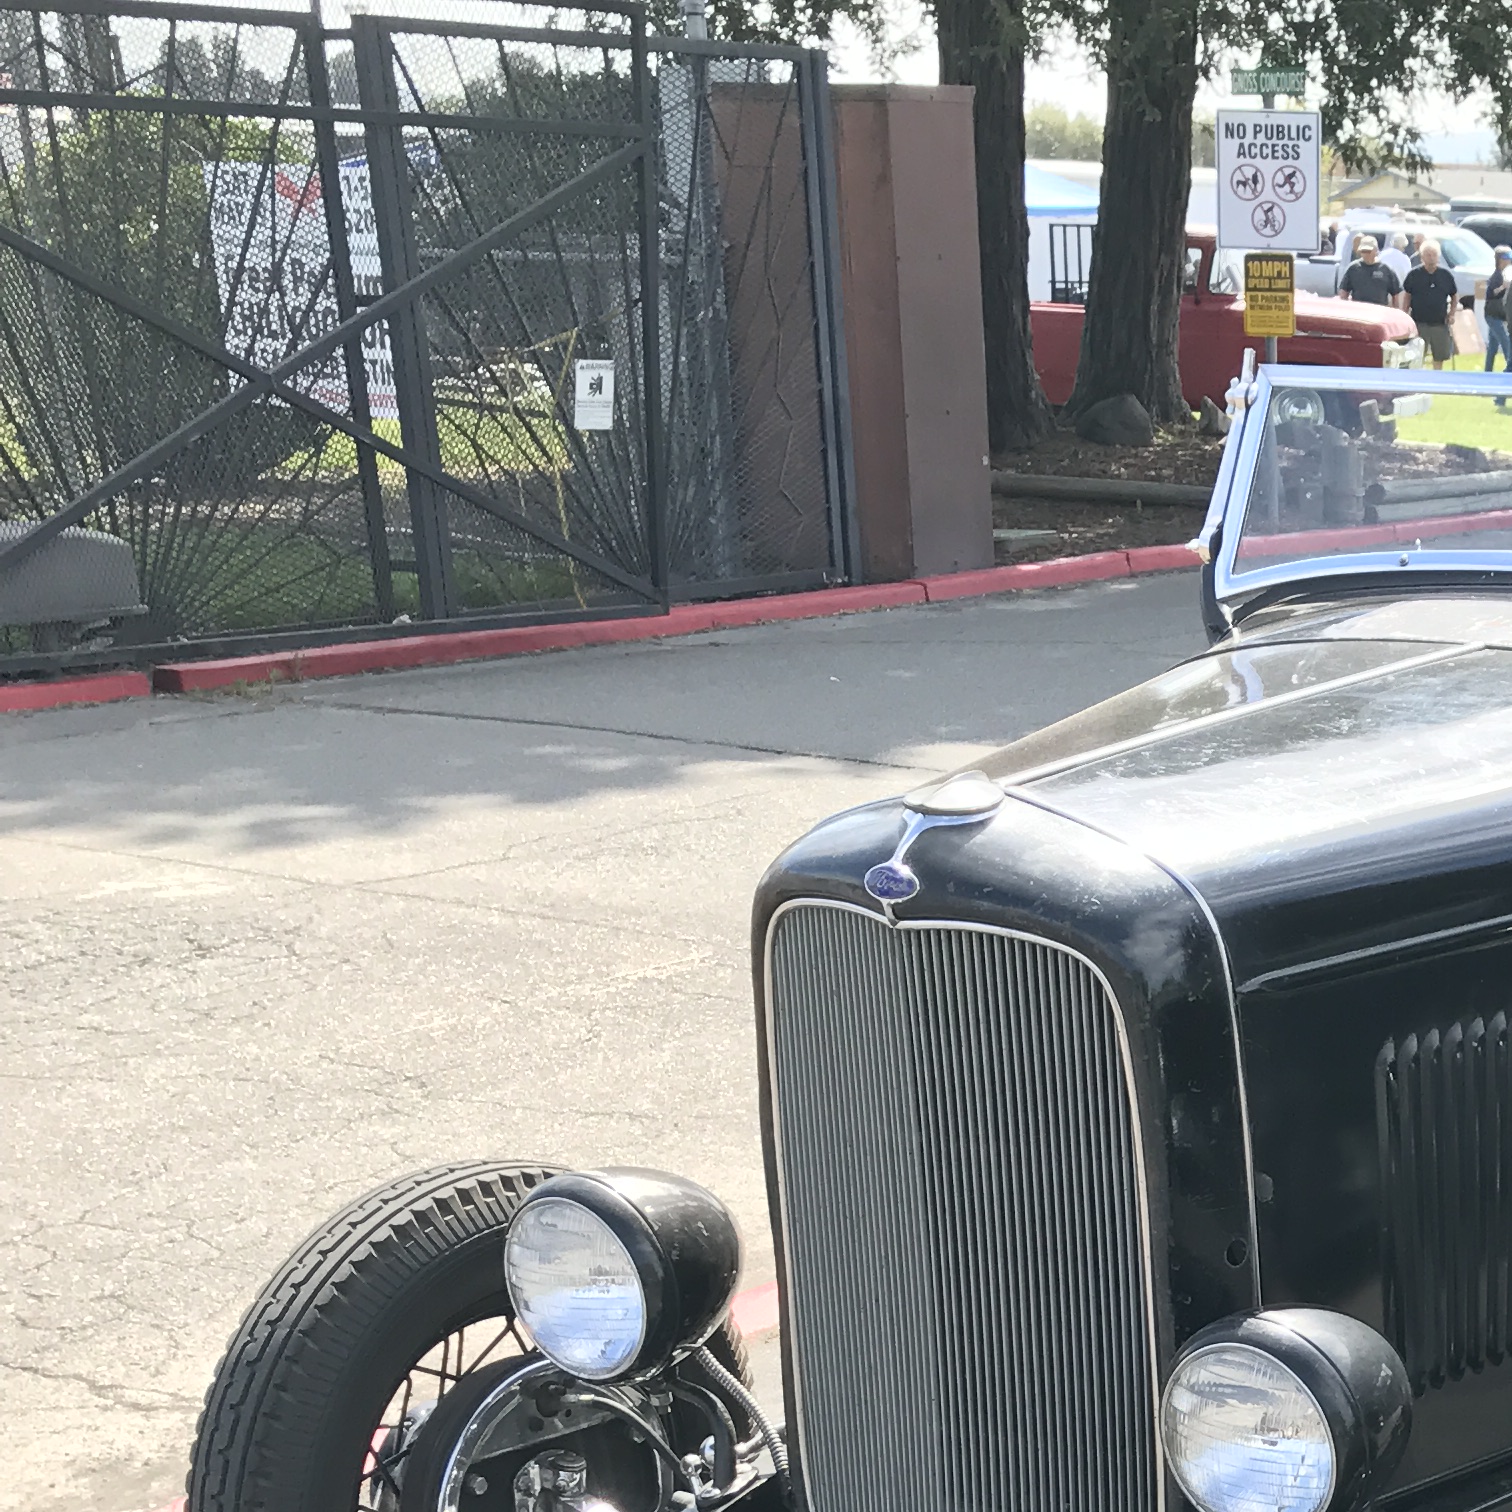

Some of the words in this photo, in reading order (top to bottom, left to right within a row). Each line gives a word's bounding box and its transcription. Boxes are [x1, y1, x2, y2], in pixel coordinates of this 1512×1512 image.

[1260, 72, 1304, 92] CONCOURSE
[1225, 122, 1246, 139] NO
[1253, 124, 1312, 142] PUBLIC
[1236, 142, 1300, 160] ACCESS
[1247, 261, 1260, 277] 10
[1262, 261, 1289, 277] MPH
[1248, 278, 1269, 288] SPEED
[1272, 279, 1290, 288] LIMIT
[1261, 295, 1289, 304] PARKING
